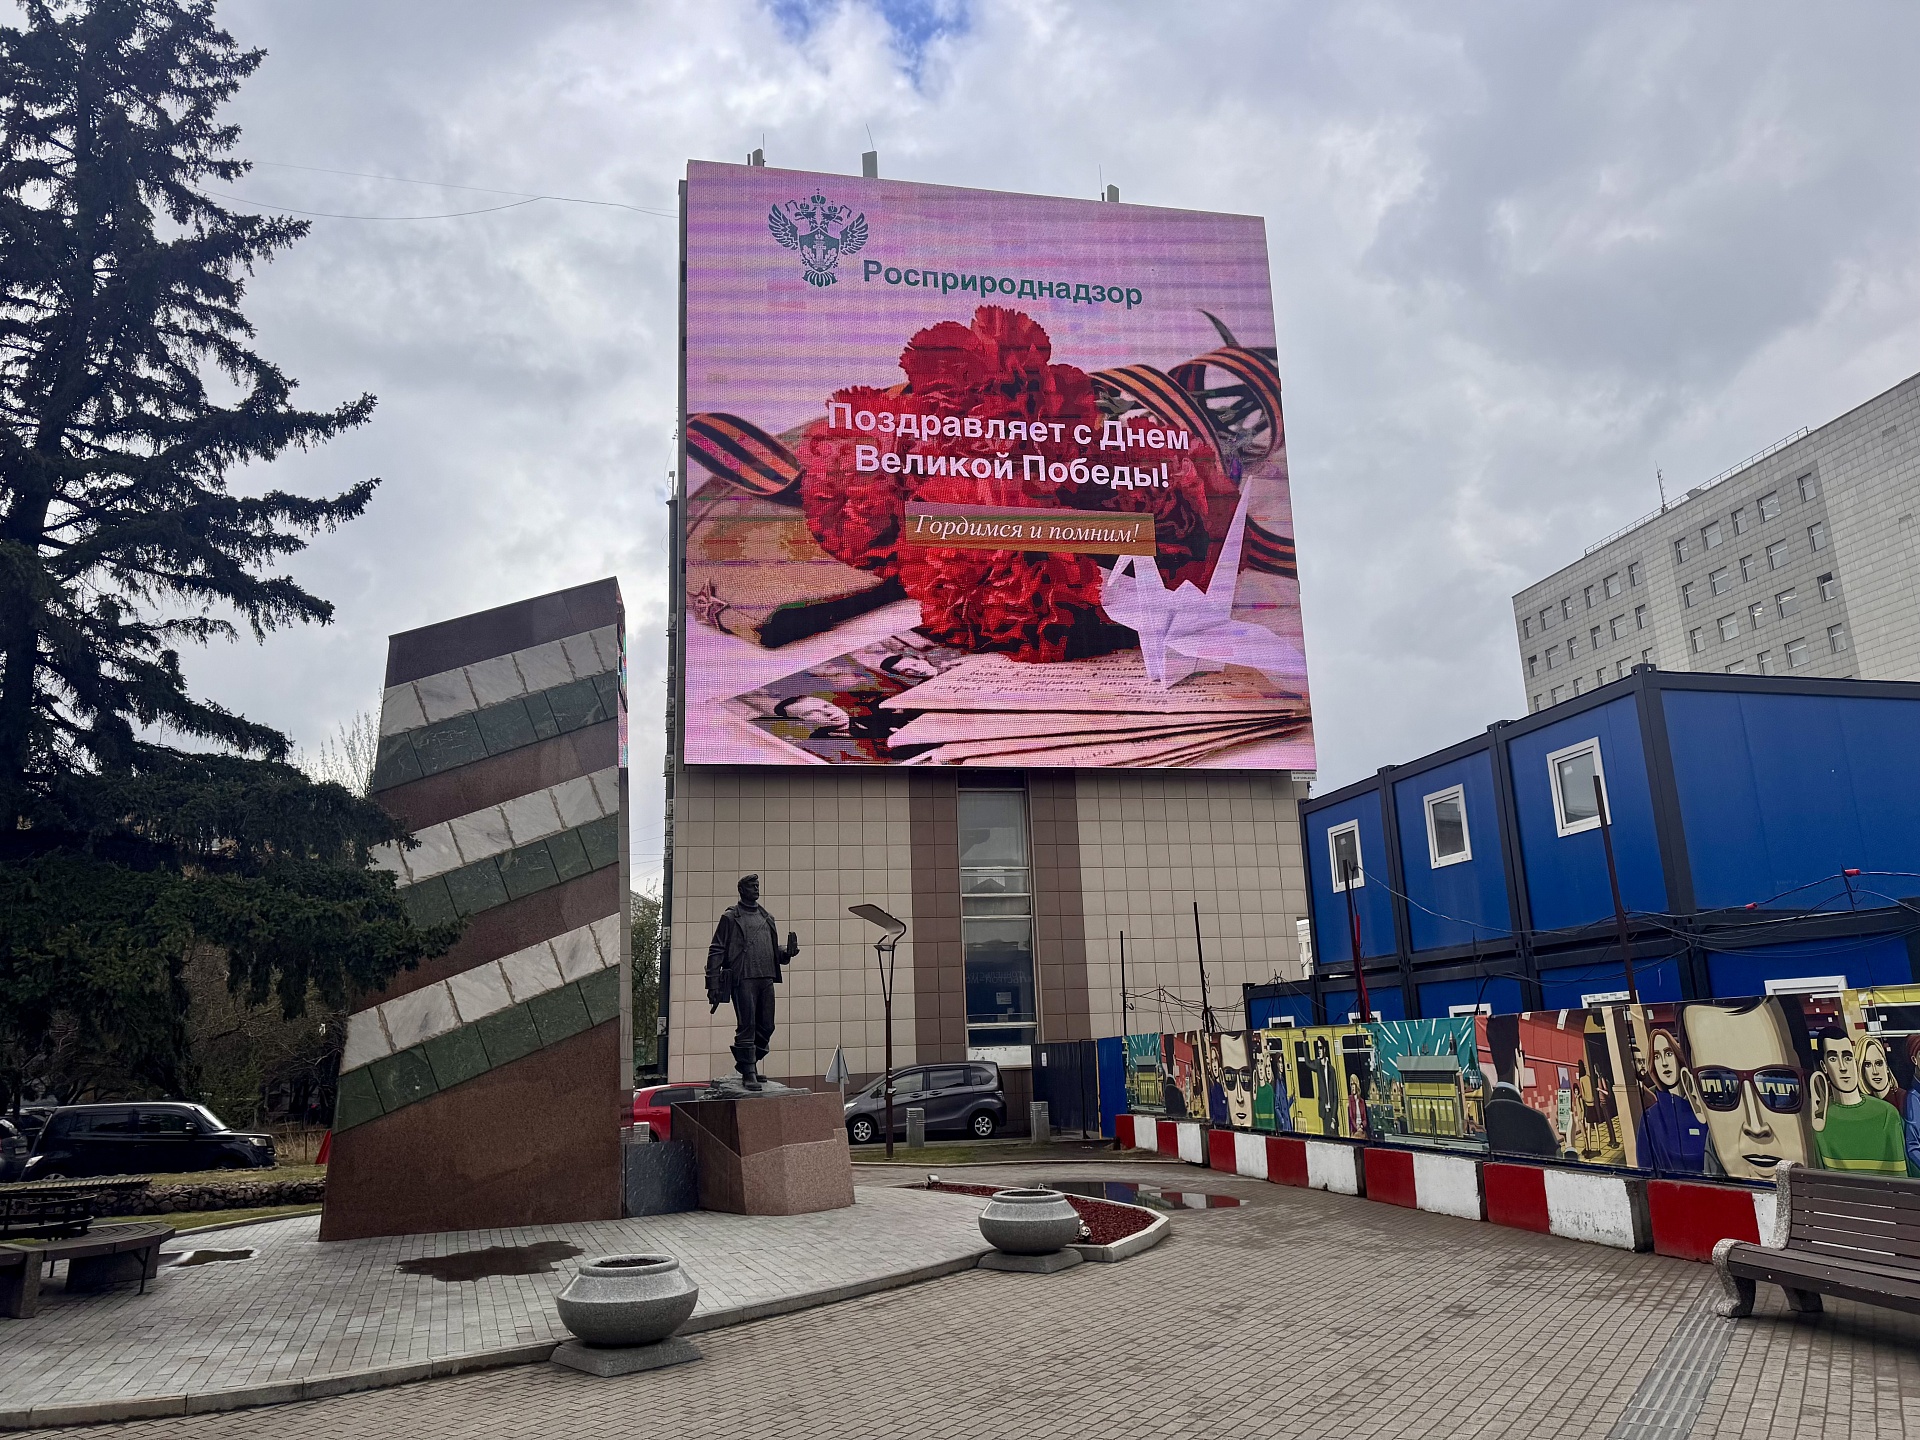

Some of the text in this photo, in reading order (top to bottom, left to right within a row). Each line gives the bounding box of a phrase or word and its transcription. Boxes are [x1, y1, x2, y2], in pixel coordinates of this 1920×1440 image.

[863, 260, 1142, 309] Росприроднадзор
[828, 402, 1189, 451] Поздравляет с Днем
[856, 444, 1169, 490] Великой Победы!
[915, 514, 1140, 543] Гордимся и помним!
